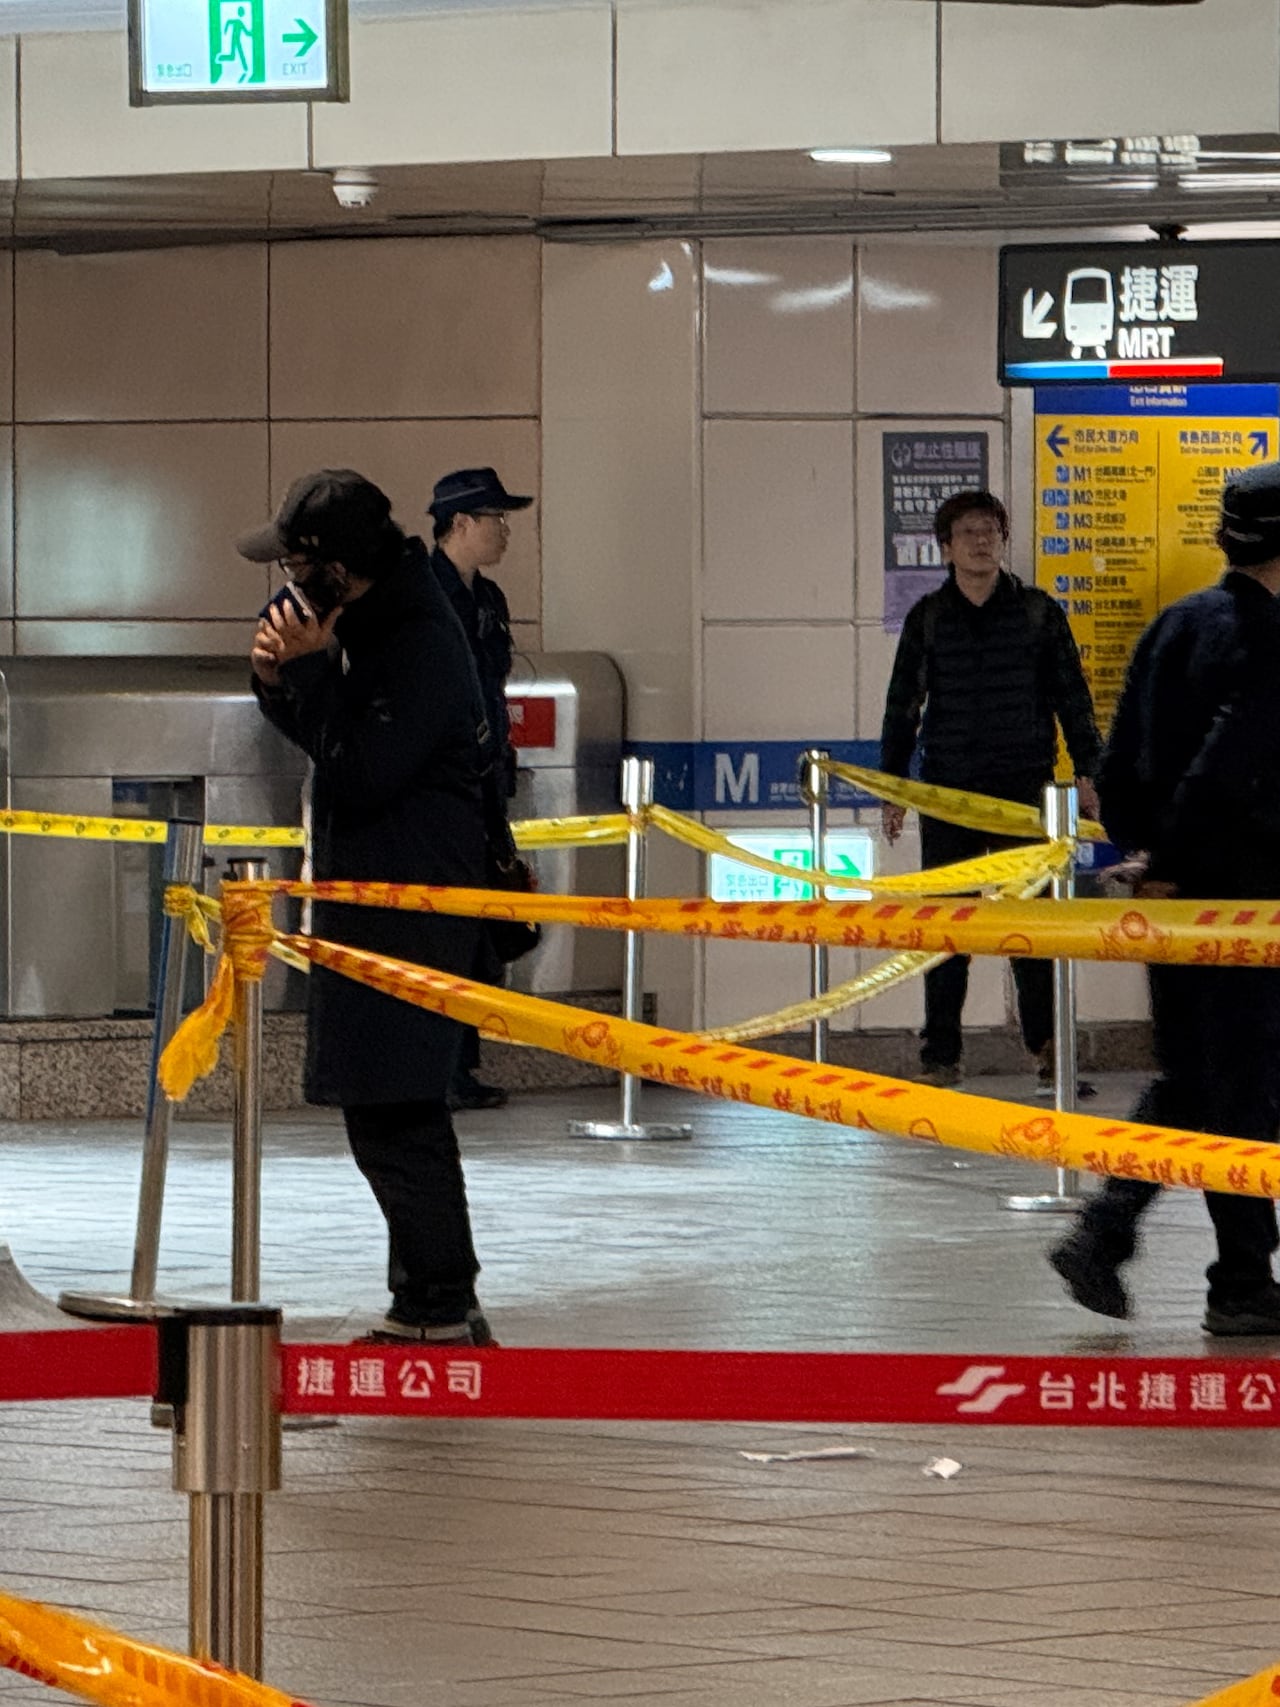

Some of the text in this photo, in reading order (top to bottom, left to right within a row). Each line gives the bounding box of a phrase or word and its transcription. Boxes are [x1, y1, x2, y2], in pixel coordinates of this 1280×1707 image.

[282, 63, 308, 76] EXIT
[1118, 264, 1199, 323] 捷運
[1117, 327, 1176, 359] MRT
[1073, 466, 1092, 482] M1
[1073, 489, 1094, 505] M2
[1073, 513, 1093, 529] M3
[1073, 537, 1092, 552] M4
[1073, 575, 1093, 592] M5
[715, 753, 760, 803] M
[297, 1355, 486, 1400] 捷運公司
